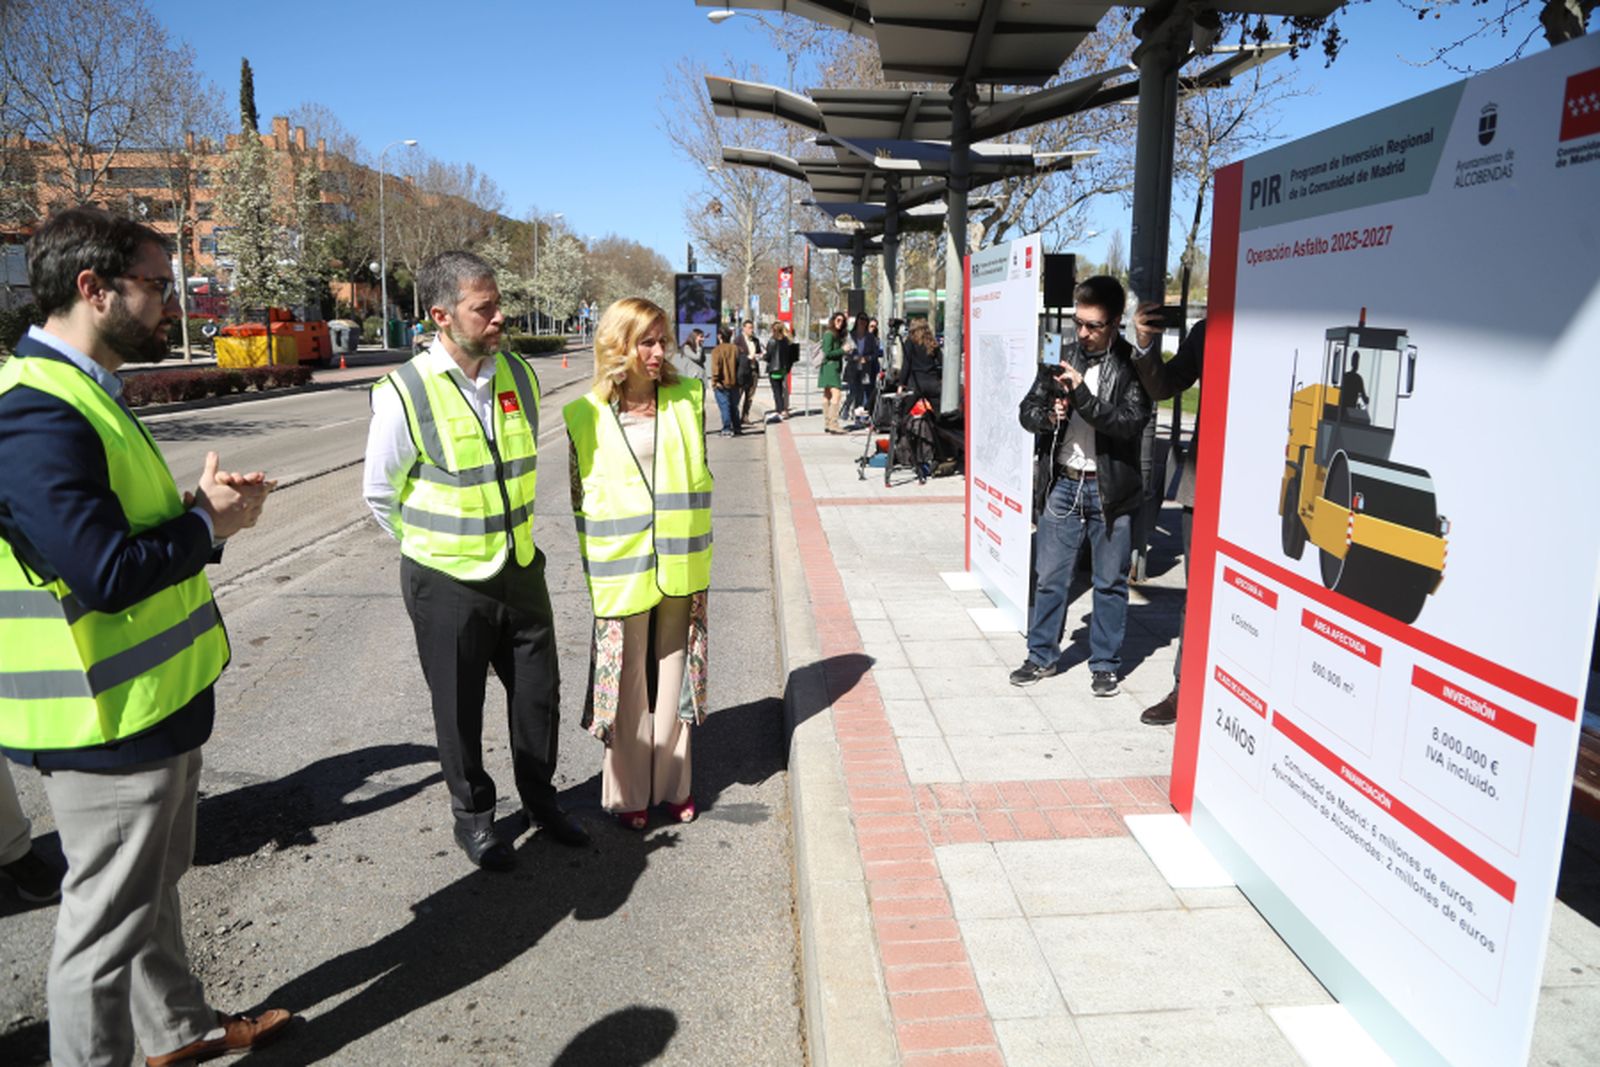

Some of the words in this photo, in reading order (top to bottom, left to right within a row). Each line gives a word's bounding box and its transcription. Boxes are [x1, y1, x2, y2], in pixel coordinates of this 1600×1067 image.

[1290, 162, 1327, 182] Programa
[1329, 157, 1340, 169] de
[1342, 145, 1384, 168] Inversión
[1386, 127, 1435, 155] Regional
[1456, 153, 1503, 173] Ayuntamiento
[1505, 148, 1515, 161] de
[1555, 158, 1567, 168] de
[1249, 173, 1282, 210] PIR
[1289, 188, 1299, 200] de
[1300, 183, 1307, 197] la
[1308, 171, 1355, 195] Comunidad
[1357, 169, 1368, 182] de
[1370, 157, 1406, 180] Madrid
[1454, 163, 1514, 189] ALCOBENDAS
[1246, 242, 1291, 267] Operación
[1292, 234, 1329, 259] Asfalto
[1331, 225, 1393, 252] 2025-2027
[1331, 629, 1367, 656] AFECTADA
[1442, 685, 1497, 721] INVERSIÓN
[1216, 708, 1223, 728] 2
[1223, 714, 1257, 756] AÑOS
[1432, 726, 1488, 769] 8.000.000
[1490, 760, 1500, 777] €
[1425, 744, 1445, 768] IVA
[1446, 757, 1500, 801] incluido.
[1283, 754, 1326, 796] Comunidad
[1326, 789, 1336, 804] de
[1336, 797, 1370, 832] Madrid:
[1378, 832, 1421, 873] millones
[1423, 866, 1437, 885] de
[1439, 880, 1477, 916] euros.
[1271, 762, 1319, 810] Ayuntamiento
[1319, 804, 1331, 820] de
[1330, 813, 1384, 864] Alcobendas:
[1385, 856, 1394, 872] 2
[1394, 865, 1439, 909] millones
[1441, 903, 1457, 923] de
[1459, 918, 1497, 954] euros
